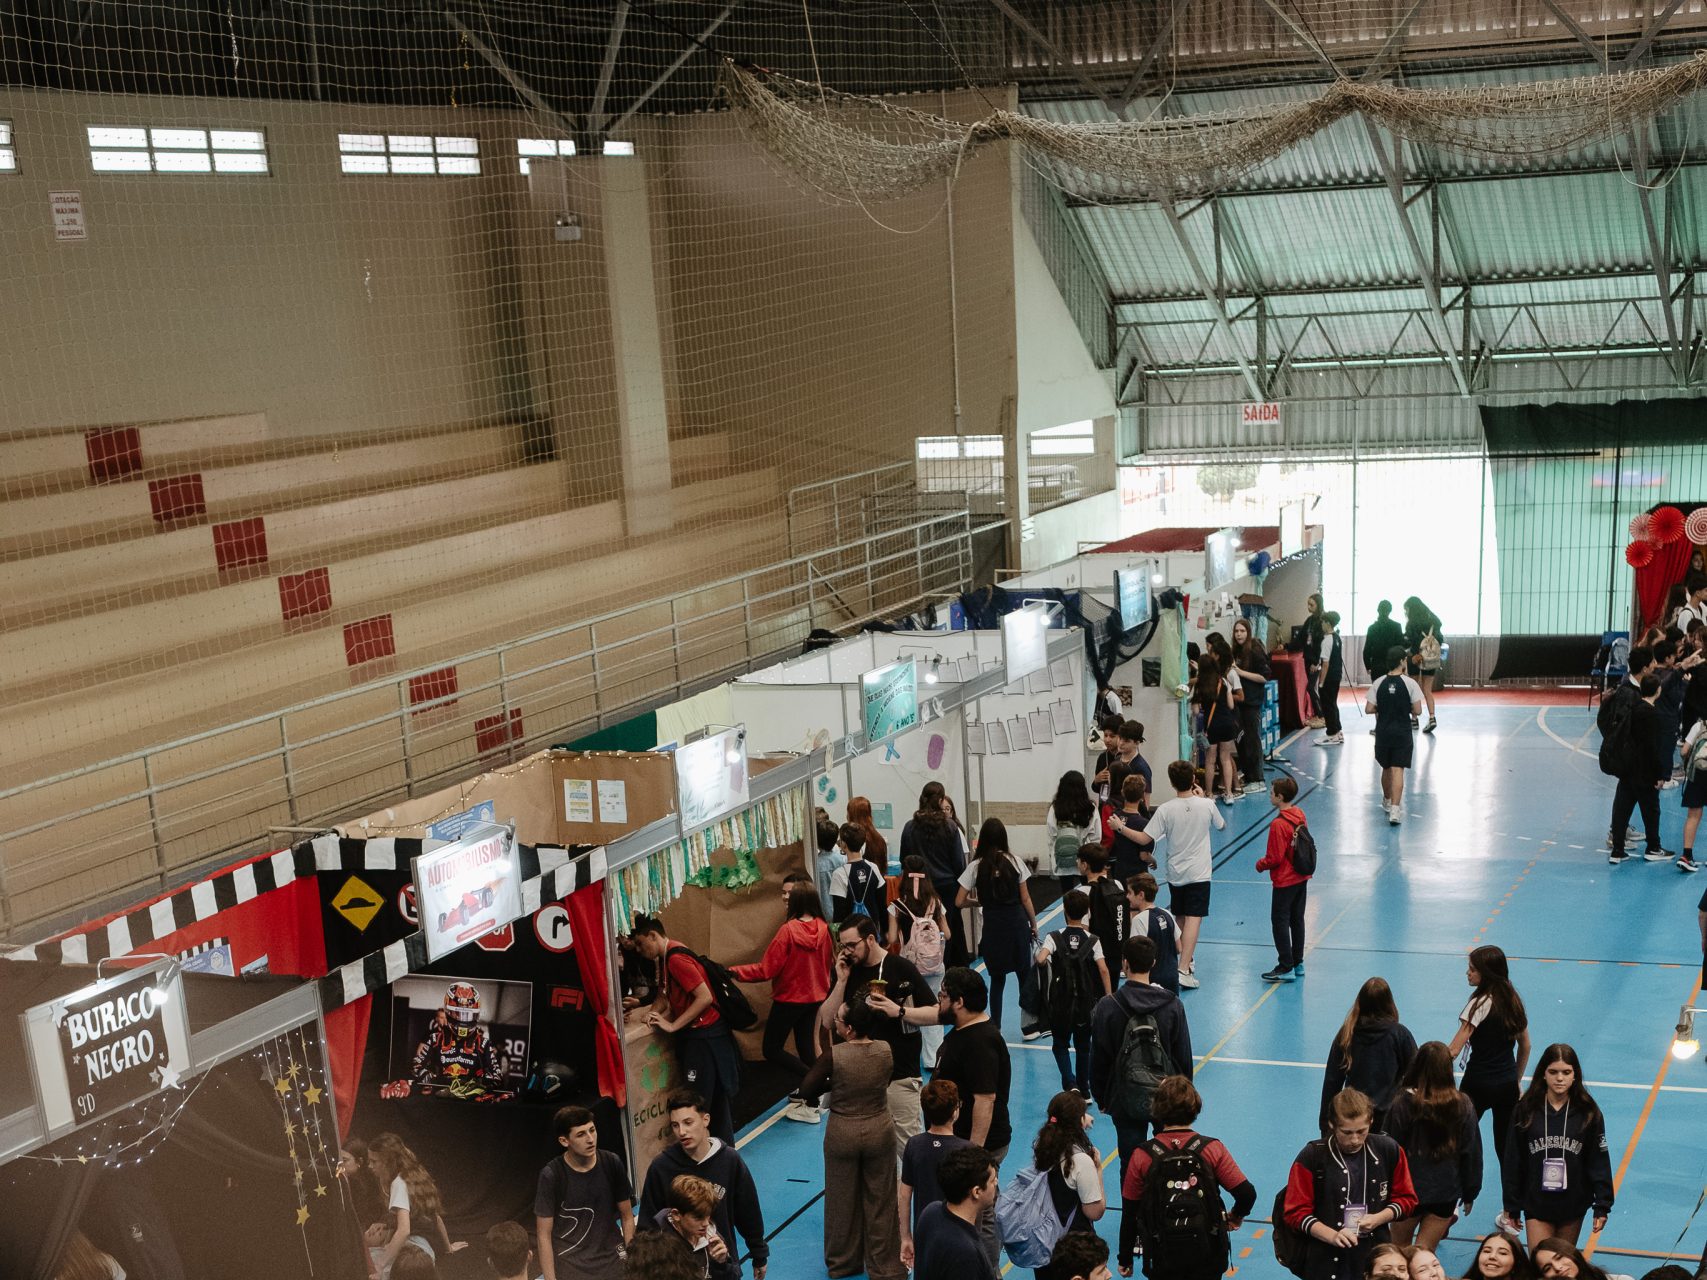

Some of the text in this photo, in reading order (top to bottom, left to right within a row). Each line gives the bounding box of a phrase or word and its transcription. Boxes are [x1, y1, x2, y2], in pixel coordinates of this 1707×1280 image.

[1244, 403, 1279, 421] SAÍDA
[67, 986, 158, 1049] BURACO
[84, 1029, 154, 1086] NEGRO
[1529, 1135, 1583, 1155] SALESIANO
